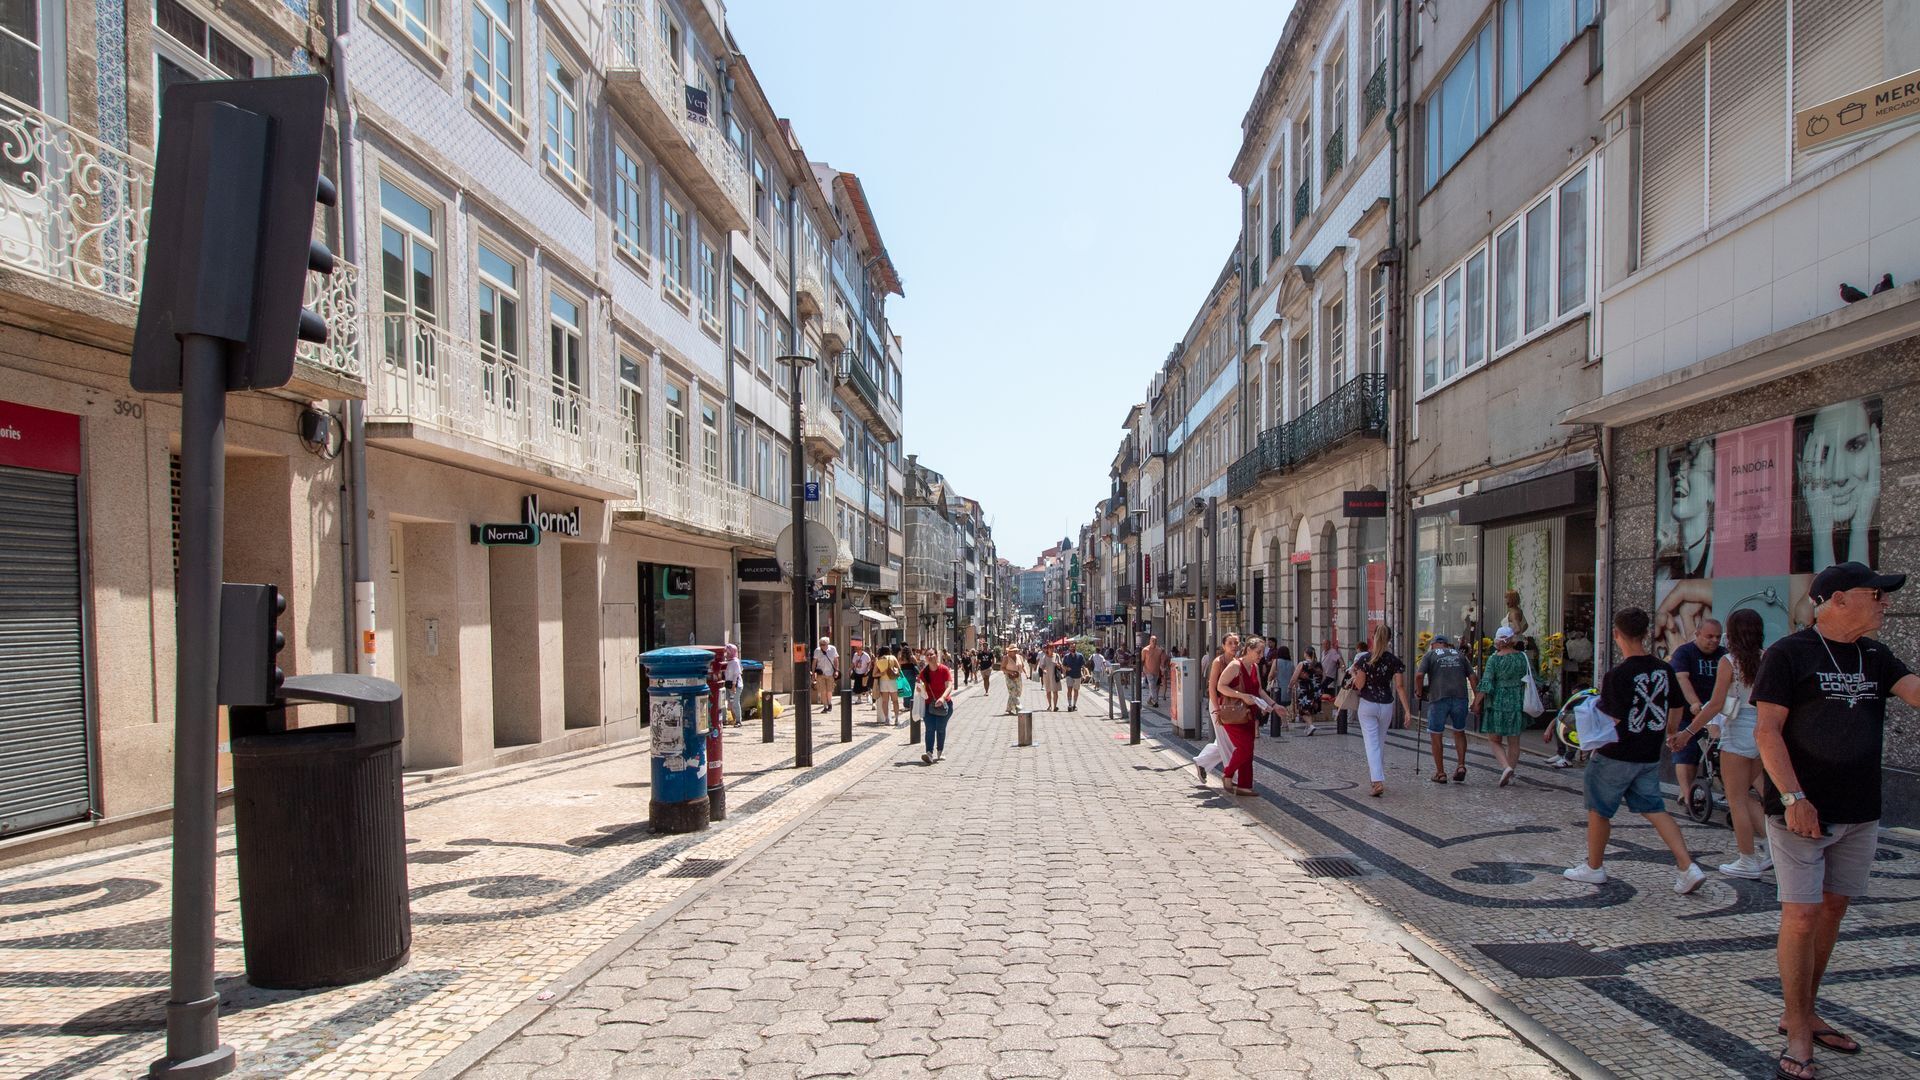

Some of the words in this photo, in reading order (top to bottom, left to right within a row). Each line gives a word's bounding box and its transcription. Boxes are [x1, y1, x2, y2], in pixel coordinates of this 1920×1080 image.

[1875, 97, 1919, 117] MERCADO
[113, 399, 142, 420] 390
[1731, 459, 1774, 476] PANDORA
[526, 494, 581, 536] Normal
[488, 528, 528, 541] Normal
[1816, 671, 1866, 683] TIFFOSI
[1820, 682, 1879, 693] CONCEPT
